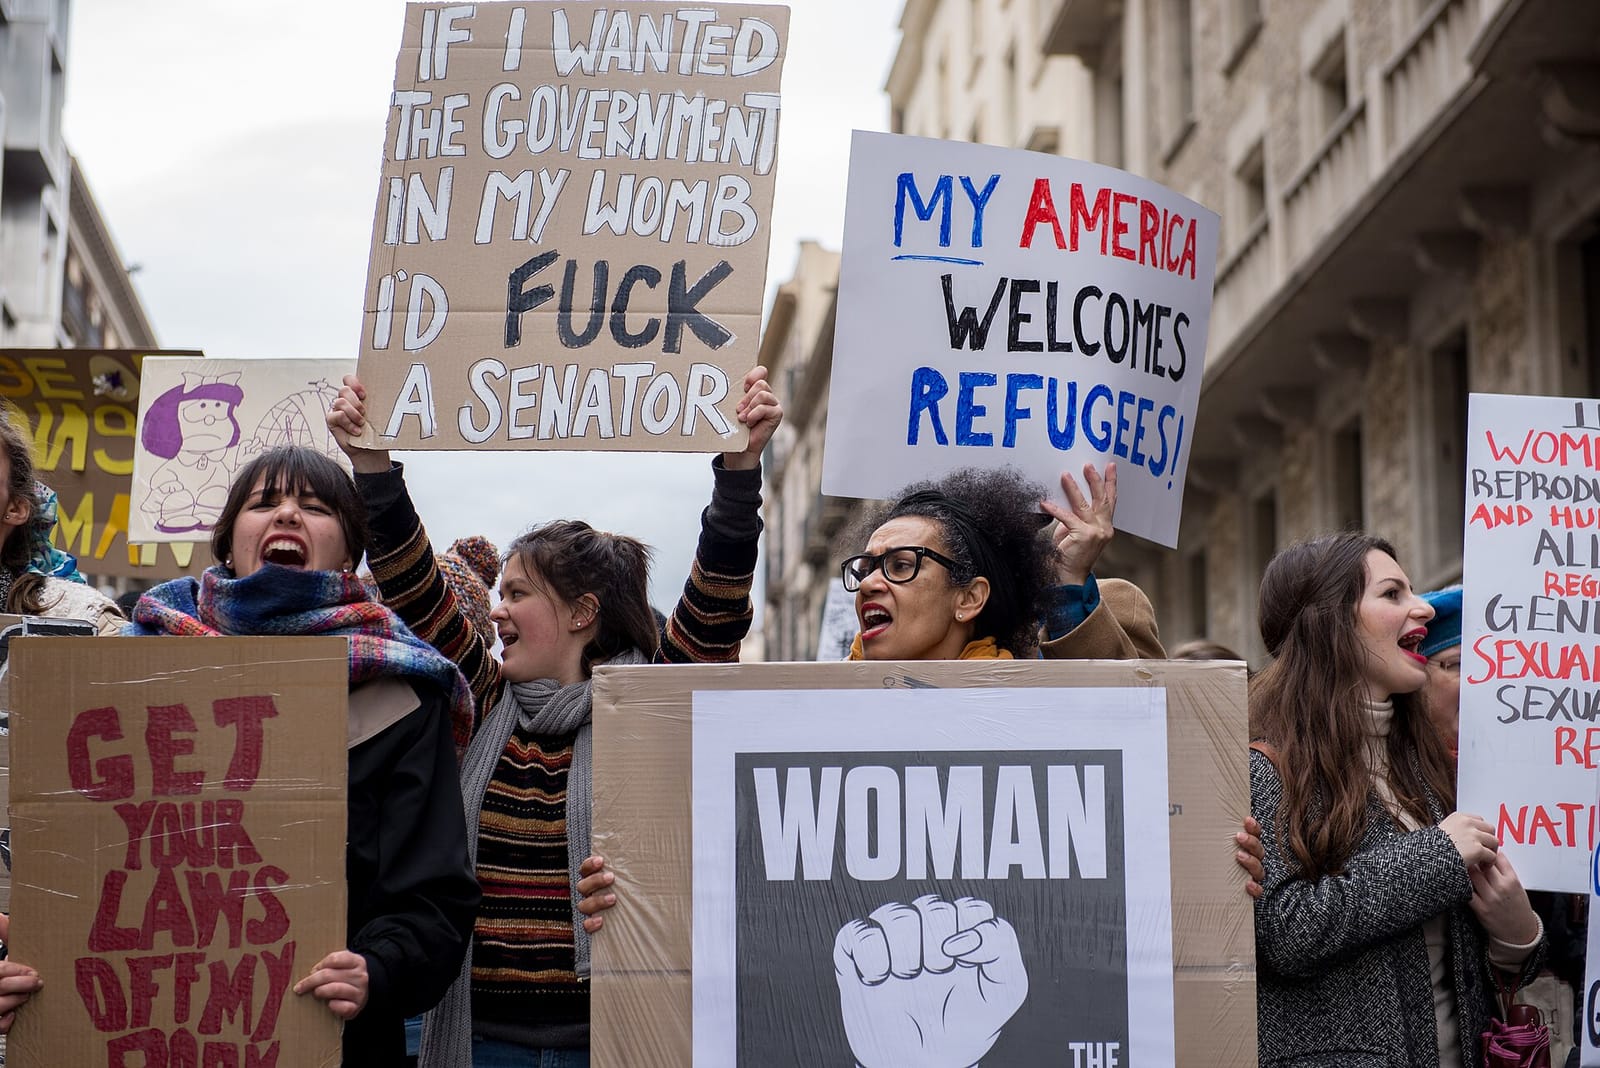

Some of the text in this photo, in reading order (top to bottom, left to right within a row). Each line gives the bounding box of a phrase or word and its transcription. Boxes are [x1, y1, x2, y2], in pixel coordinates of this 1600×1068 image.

[417, 5, 780, 83] IF I WANTED
[392, 82, 781, 176] THE GOVERNMENT
[384, 166, 758, 247] IN MY WOMB
[892, 172, 1196, 280] MY AMERICA
[372, 249, 736, 354] I'D FUCK
[940, 273, 1190, 382] WELCOMES
[379, 357, 739, 443] A SENATOR
[906, 366, 1184, 490] REFUGEES!
[1485, 429, 1600, 471] WOM
[1469, 503, 1600, 530] AND HU
[1485, 594, 1600, 634] GEN
[1544, 570, 1600, 599] REG
[66, 696, 279, 801] GET
[114, 799, 263, 870] YOUR
[753, 764, 1108, 881] WOMAN
[88, 865, 291, 952] LAWS
[75, 941, 296, 1043] OFF MY
